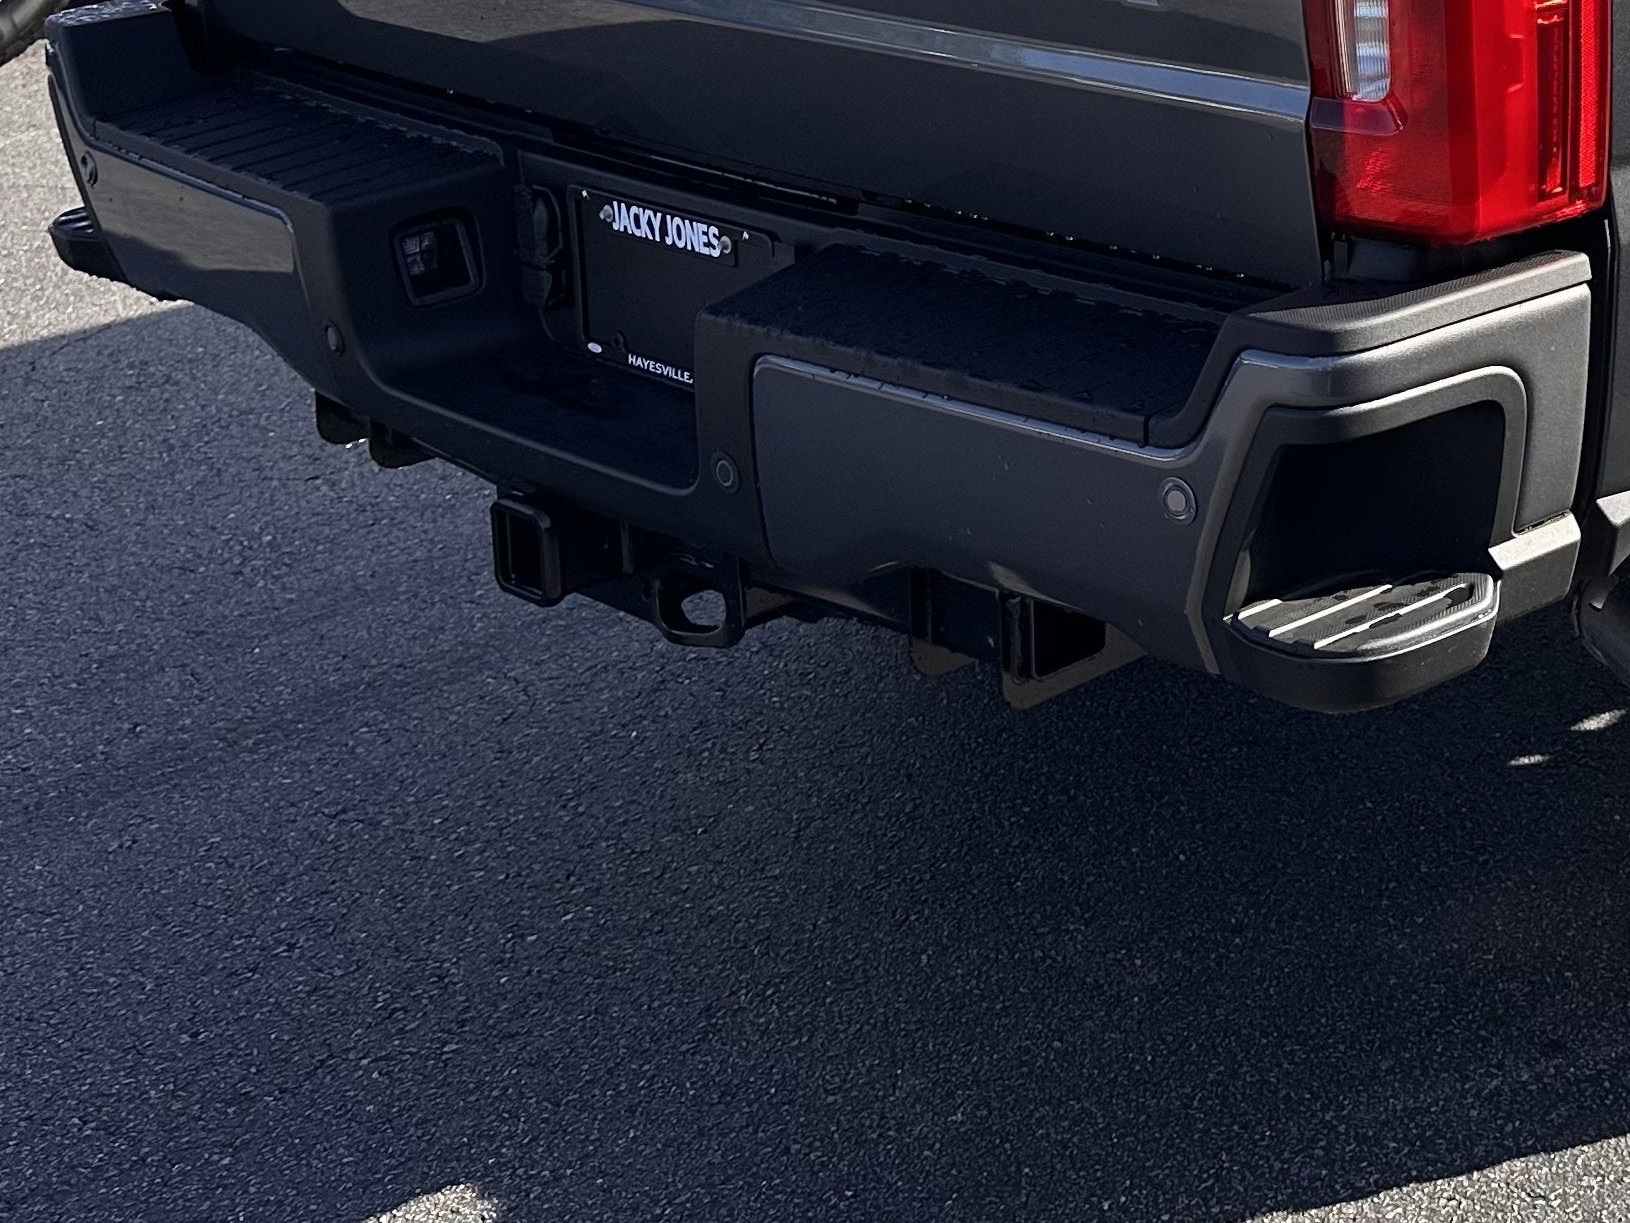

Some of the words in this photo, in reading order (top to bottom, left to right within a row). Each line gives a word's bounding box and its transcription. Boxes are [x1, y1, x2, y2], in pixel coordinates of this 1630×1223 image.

[612, 200, 662, 242] JACKY
[665, 214, 721, 258] JONES
[628, 353, 694, 384] HAYESVILLE,
